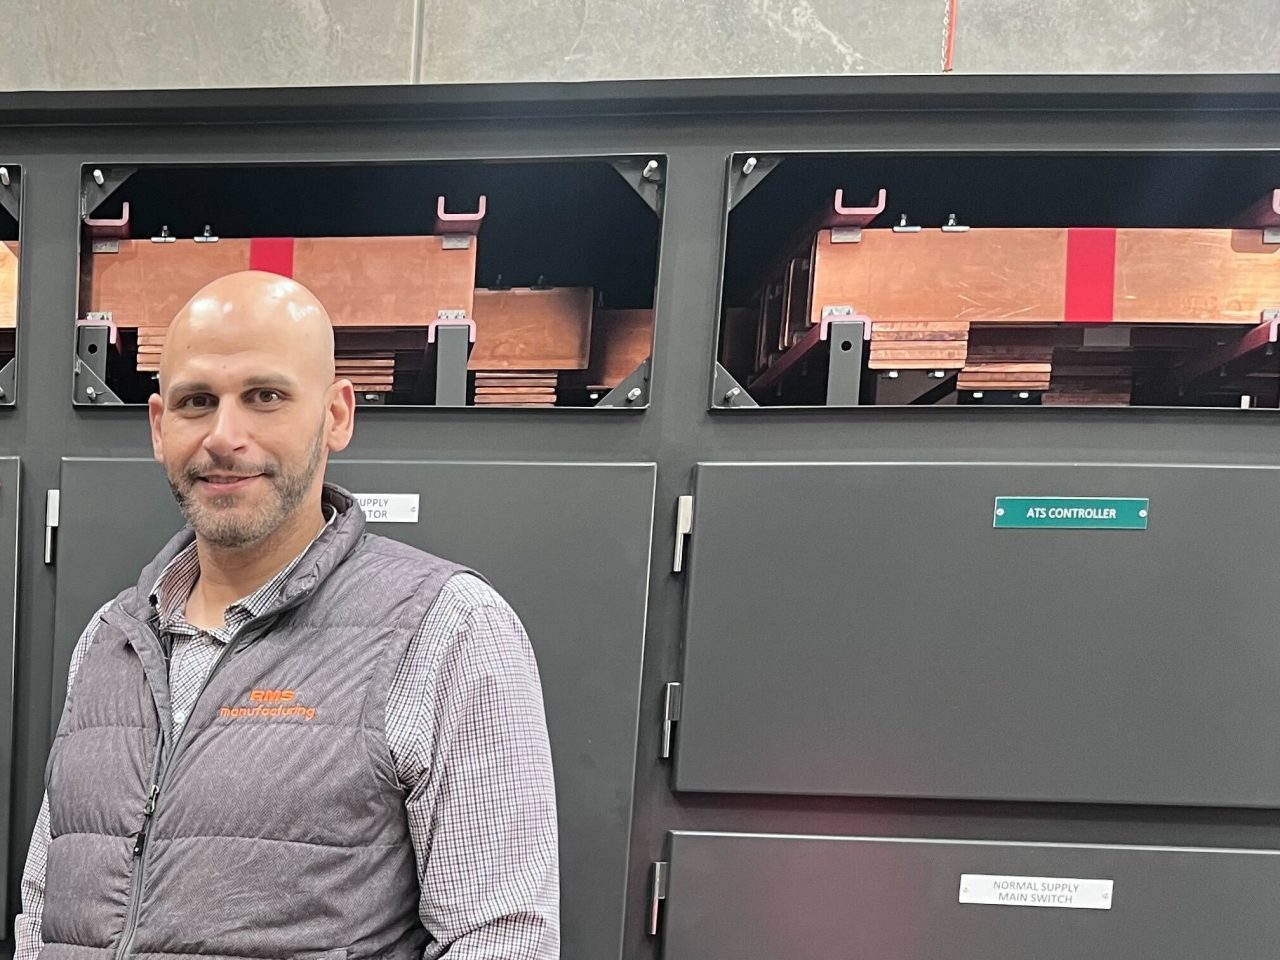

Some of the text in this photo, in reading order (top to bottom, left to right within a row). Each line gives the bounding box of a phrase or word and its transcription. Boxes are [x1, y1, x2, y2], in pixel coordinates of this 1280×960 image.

[358, 498, 389, 507] UPPLY
[1026, 507, 1116, 519] ATS CONTROLLER
[249, 689, 295, 702] RMS
[220, 704, 316, 721] manufacturing
[993, 881, 1079, 893] NORMAL SUPPLY
[998, 892, 1073, 904] MAIN SWITCH
